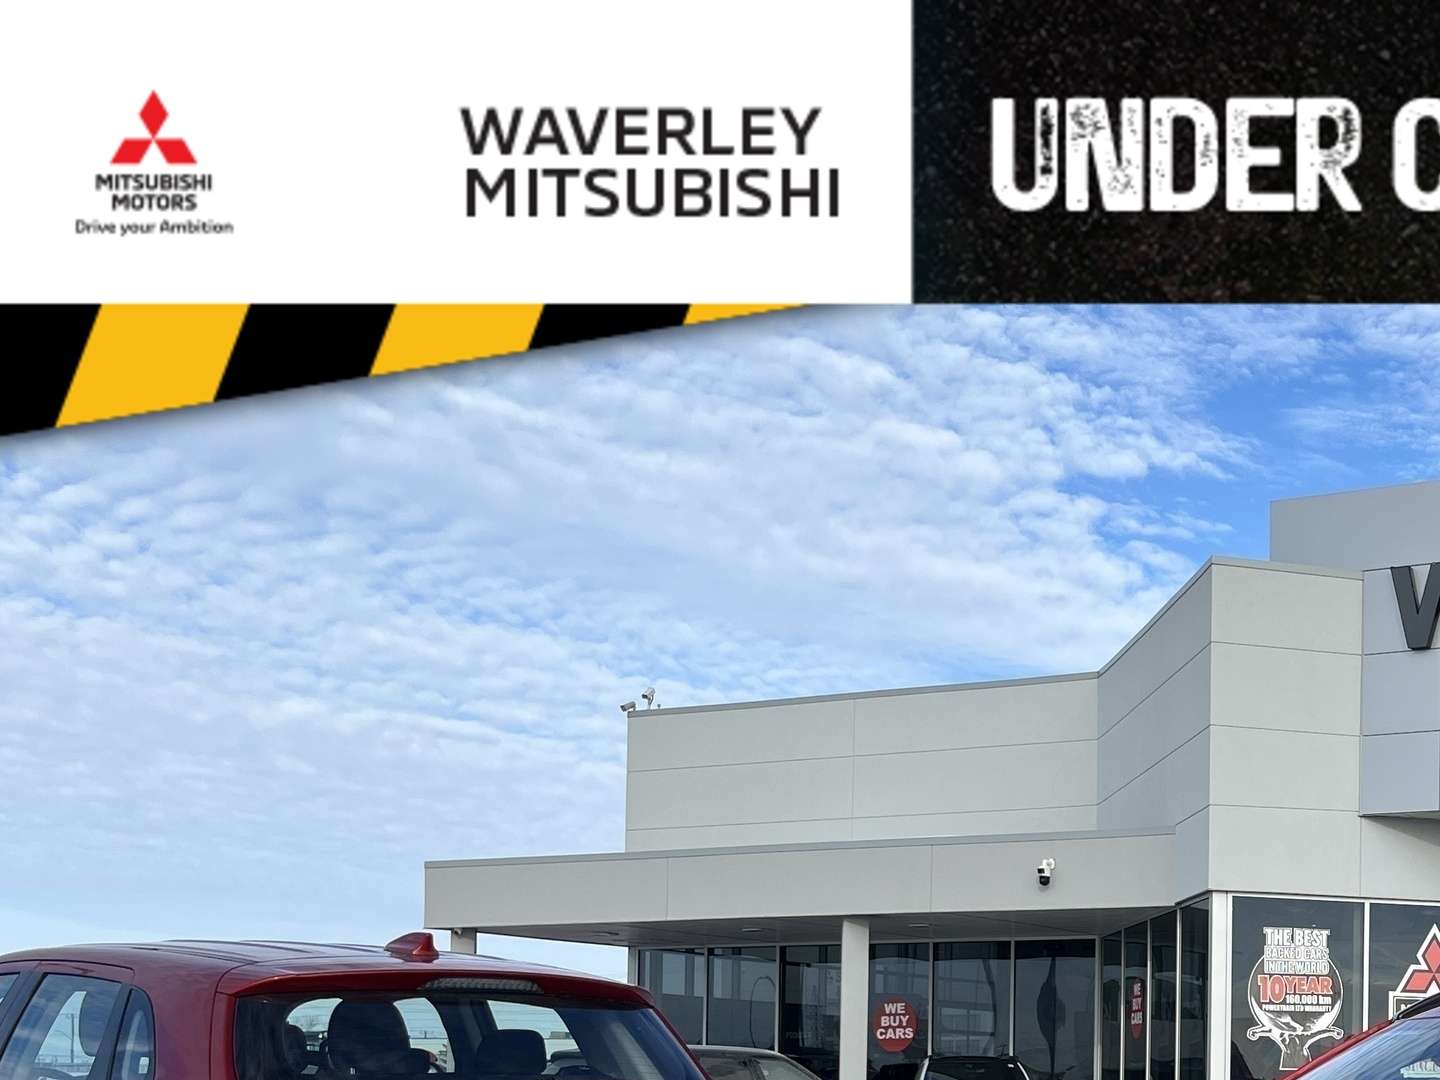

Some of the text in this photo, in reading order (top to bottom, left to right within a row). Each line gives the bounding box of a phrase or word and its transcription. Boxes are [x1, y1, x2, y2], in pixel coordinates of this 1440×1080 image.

[1264, 927, 1330, 947] THE BEST
[1264, 946, 1300, 960] BACKED
[1295, 961, 1329, 975] WORLD
[1258, 975, 1333, 1003] 10 YEAR
[884, 1003, 906, 1014] WE
[880, 1015, 909, 1027] BUY
[876, 1027, 914, 1040] CARS
